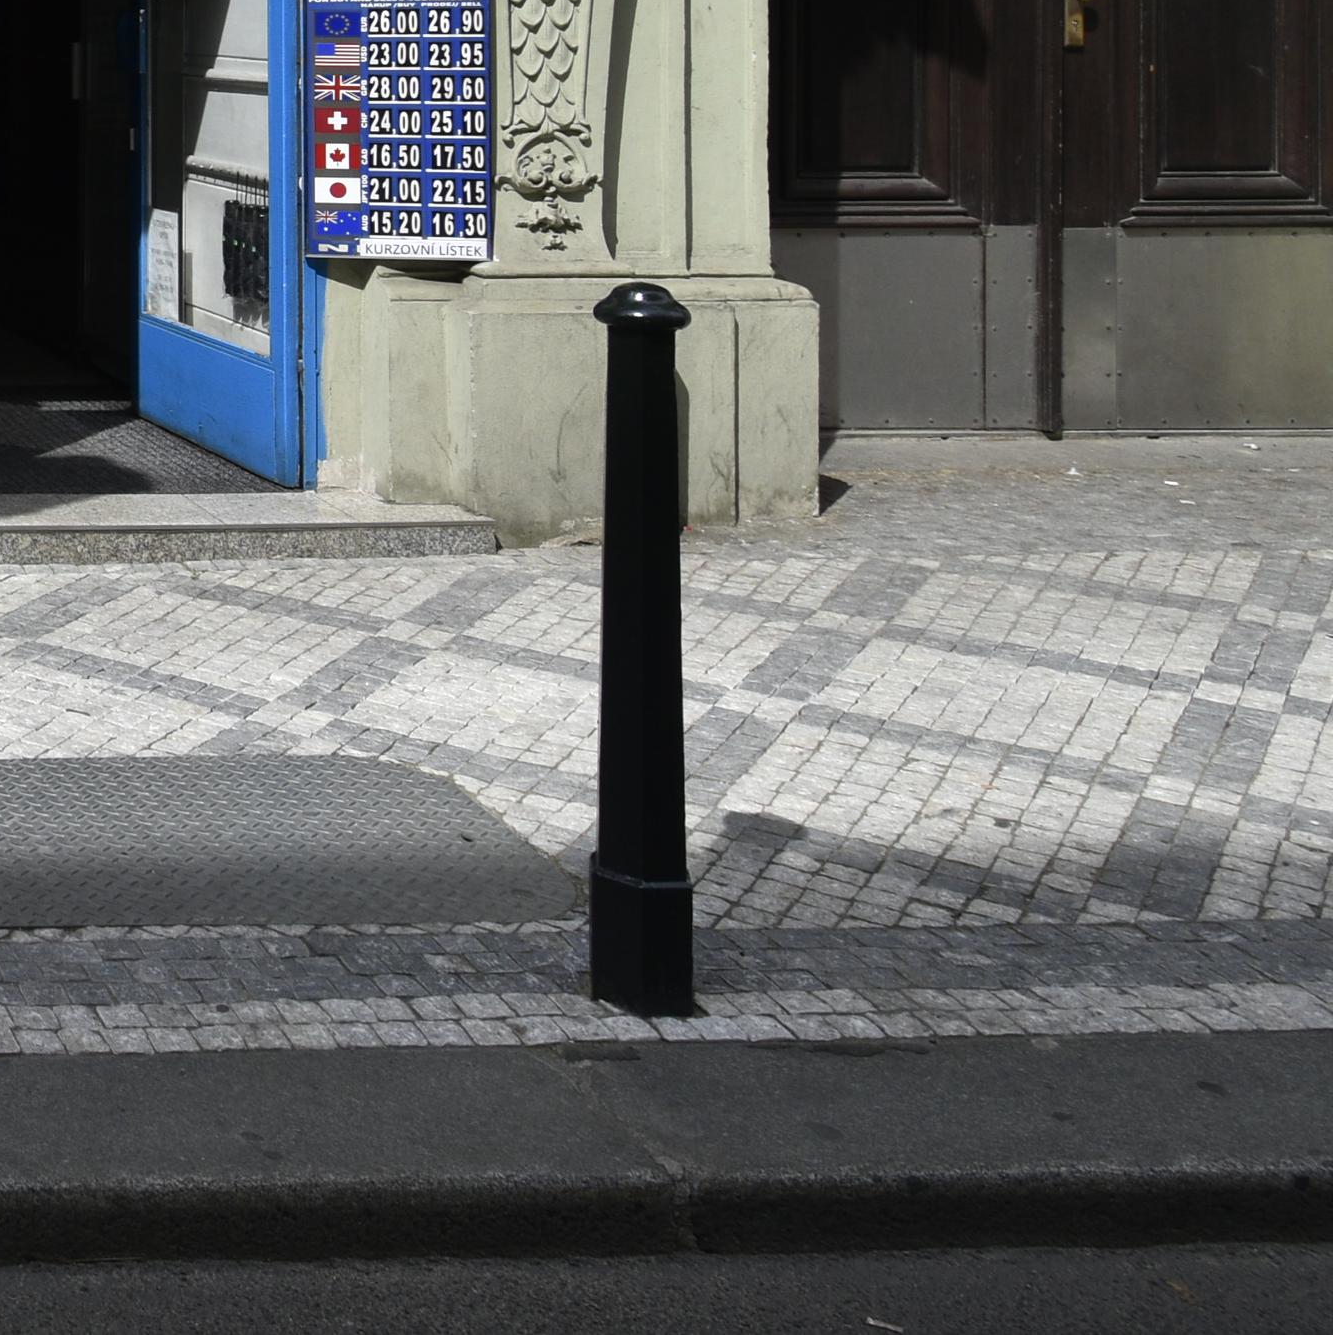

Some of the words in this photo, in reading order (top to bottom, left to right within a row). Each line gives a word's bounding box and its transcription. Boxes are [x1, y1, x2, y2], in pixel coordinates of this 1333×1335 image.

[369, 10, 418, 34] 26,00
[428, 10, 483, 34] 26,90
[369, 43, 419, 67] 23,00
[429, 43, 483, 67] 23,95
[369, 76, 419, 100] 28,00
[432, 77, 484, 101] 29,60
[370, 110, 420, 134] 24,00
[431, 111, 484, 135] 25,10
[370, 144, 419, 168] 16,50
[433, 145, 484, 169] 17,50
[370, 178, 420, 202] 21,00
[433, 180, 484, 204] 22,15
[371, 211, 421, 235] 15,20
[433, 213, 486, 237] 16,30
[365, 242, 435, 255] KURZOVNÍ
[439, 243, 482, 256] LÍSTEK
